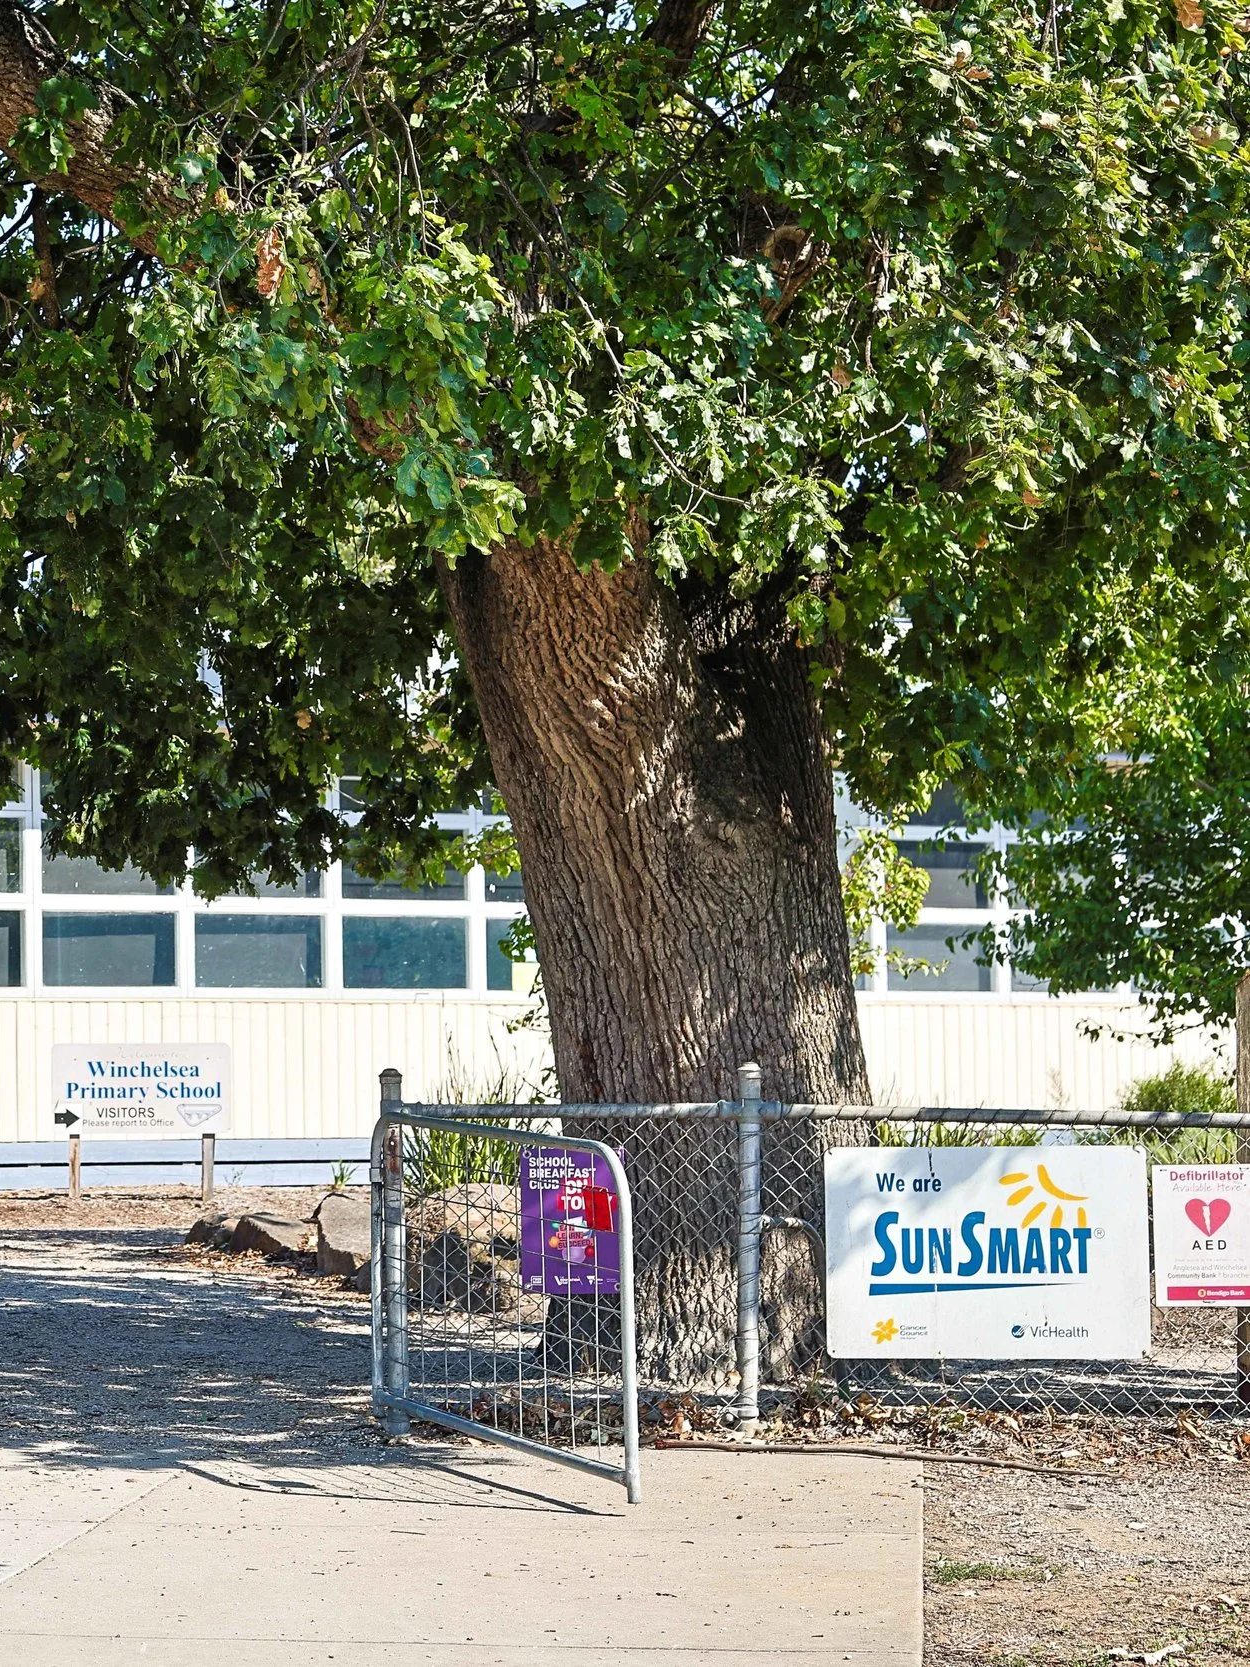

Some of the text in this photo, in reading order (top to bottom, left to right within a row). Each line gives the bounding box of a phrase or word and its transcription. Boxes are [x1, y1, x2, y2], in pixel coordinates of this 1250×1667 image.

[87, 1061, 200, 1078] Winchelsea
[67, 1081, 221, 1103] Primary School
[96, 1107, 155, 1118] VISITORS
[82, 1119, 175, 1129] Please report to Office
[529, 1157, 575, 1167] SCHOOL
[529, 1168, 596, 1179] BREAKFAST
[1170, 1170, 1244, 1181] Defibrillator
[530, 1180, 559, 1189] CLUB
[876, 1173, 942, 1192] We are
[1172, 1182, 1242, 1193] Available Here
[1192, 1240, 1227, 1250] AED
[1031, 1326, 1089, 1338] VicHealth
